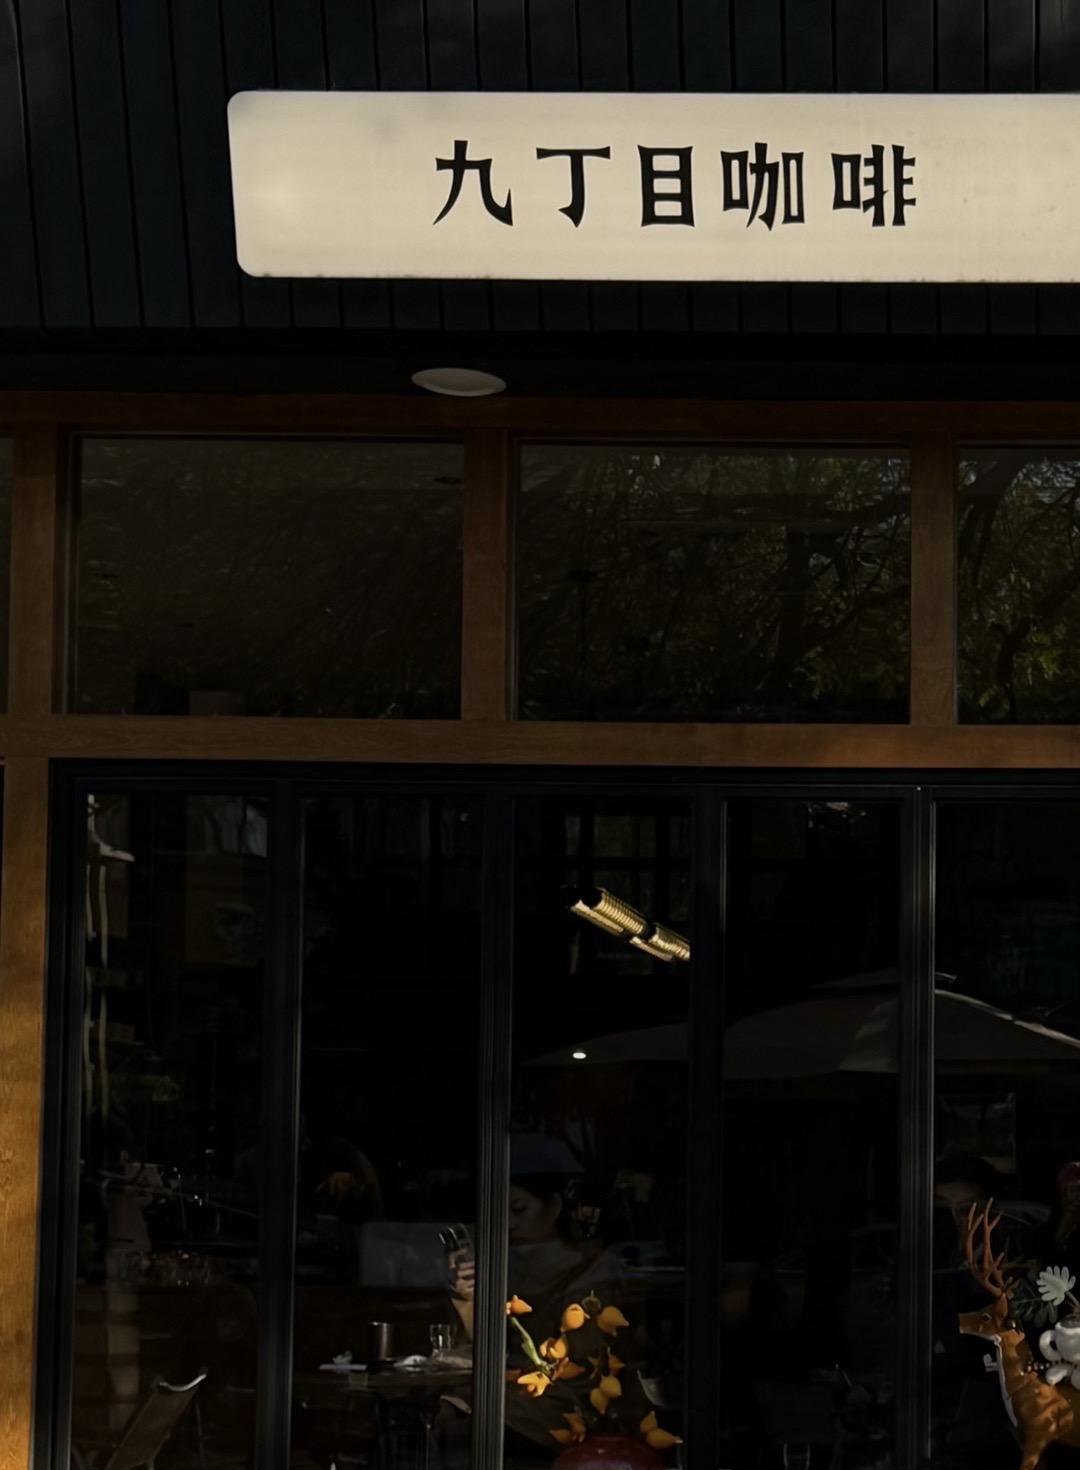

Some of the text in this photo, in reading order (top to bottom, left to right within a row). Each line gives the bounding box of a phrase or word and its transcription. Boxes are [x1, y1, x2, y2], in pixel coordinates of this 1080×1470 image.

[433, 139, 916, 230] 九丁目咖啡
